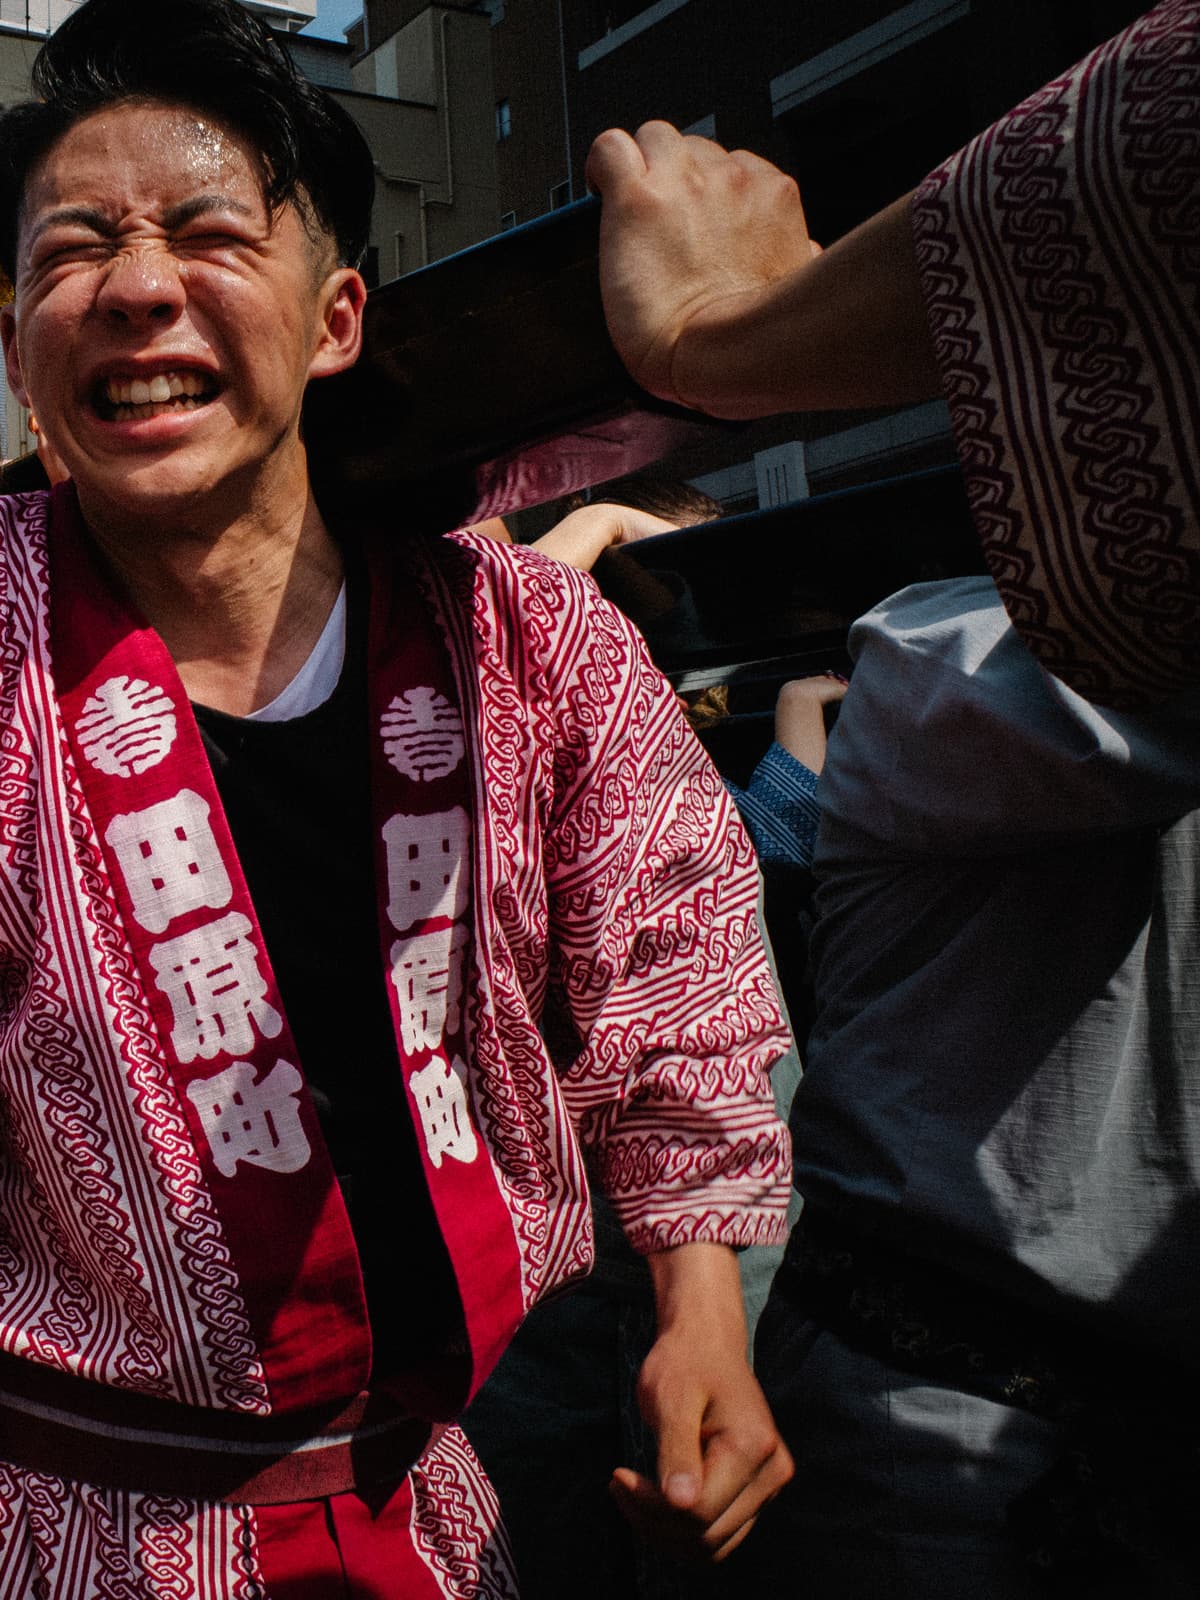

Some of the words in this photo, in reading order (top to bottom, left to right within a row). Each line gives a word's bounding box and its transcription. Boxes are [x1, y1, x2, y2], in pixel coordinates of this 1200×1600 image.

[104, 788, 312, 1178] 田原町
[381, 805, 478, 1169] 田原町
